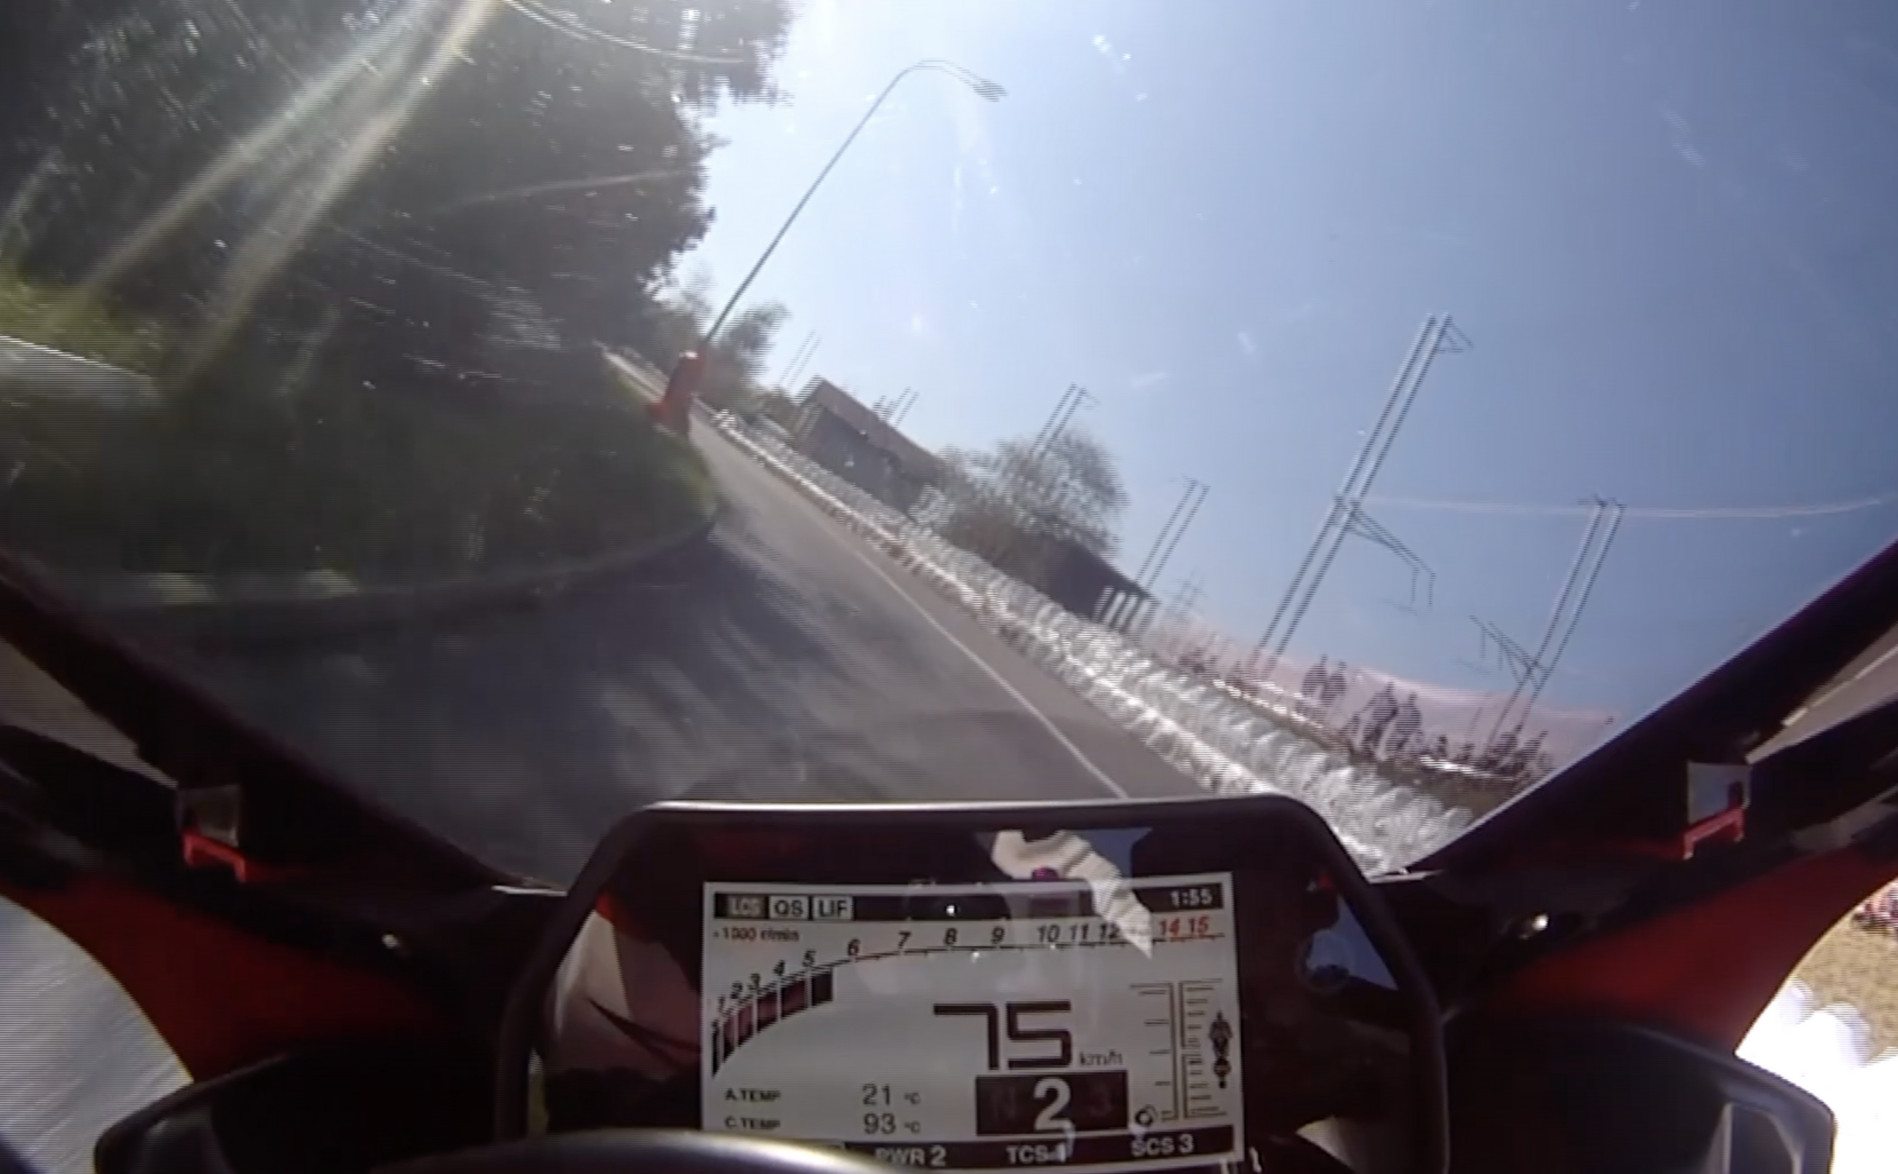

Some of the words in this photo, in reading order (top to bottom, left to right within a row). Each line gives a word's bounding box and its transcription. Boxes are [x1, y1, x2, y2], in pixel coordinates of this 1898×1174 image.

[1170, 888, 1213, 907] 1:55
[774, 900, 804, 917] QS
[819, 900, 848, 917] LIF
[1038, 924, 1061, 943] 10
[1070, 923, 1090, 942] 11
[1101, 922, 1121, 940] 12
[1159, 918, 1181, 937] 14
[1188, 915, 1211, 934] 15
[898, 930, 911, 948] 7
[944, 927, 958, 946] 8
[991, 925, 1005, 945] 9
[848, 938, 860, 957] 6
[773, 959, 786, 976] 4
[802, 949, 817, 967] 5
[933, 1000, 1073, 1071] 75
[1079, 1051, 1123, 1066] km/h
[725, 1088, 781, 1103] A.TEMP
[861, 1083, 891, 1106] 21
[1034, 1077, 1071, 1132] 2
[725, 1116, 781, 1130] C.TEMP
[863, 1112, 896, 1135] 93
[1006, 1144, 1050, 1165] TCS
[1131, 1138, 1175, 1158] SCS
[1179, 1133, 1195, 1154] 3
[930, 1145, 947, 1167] 2
